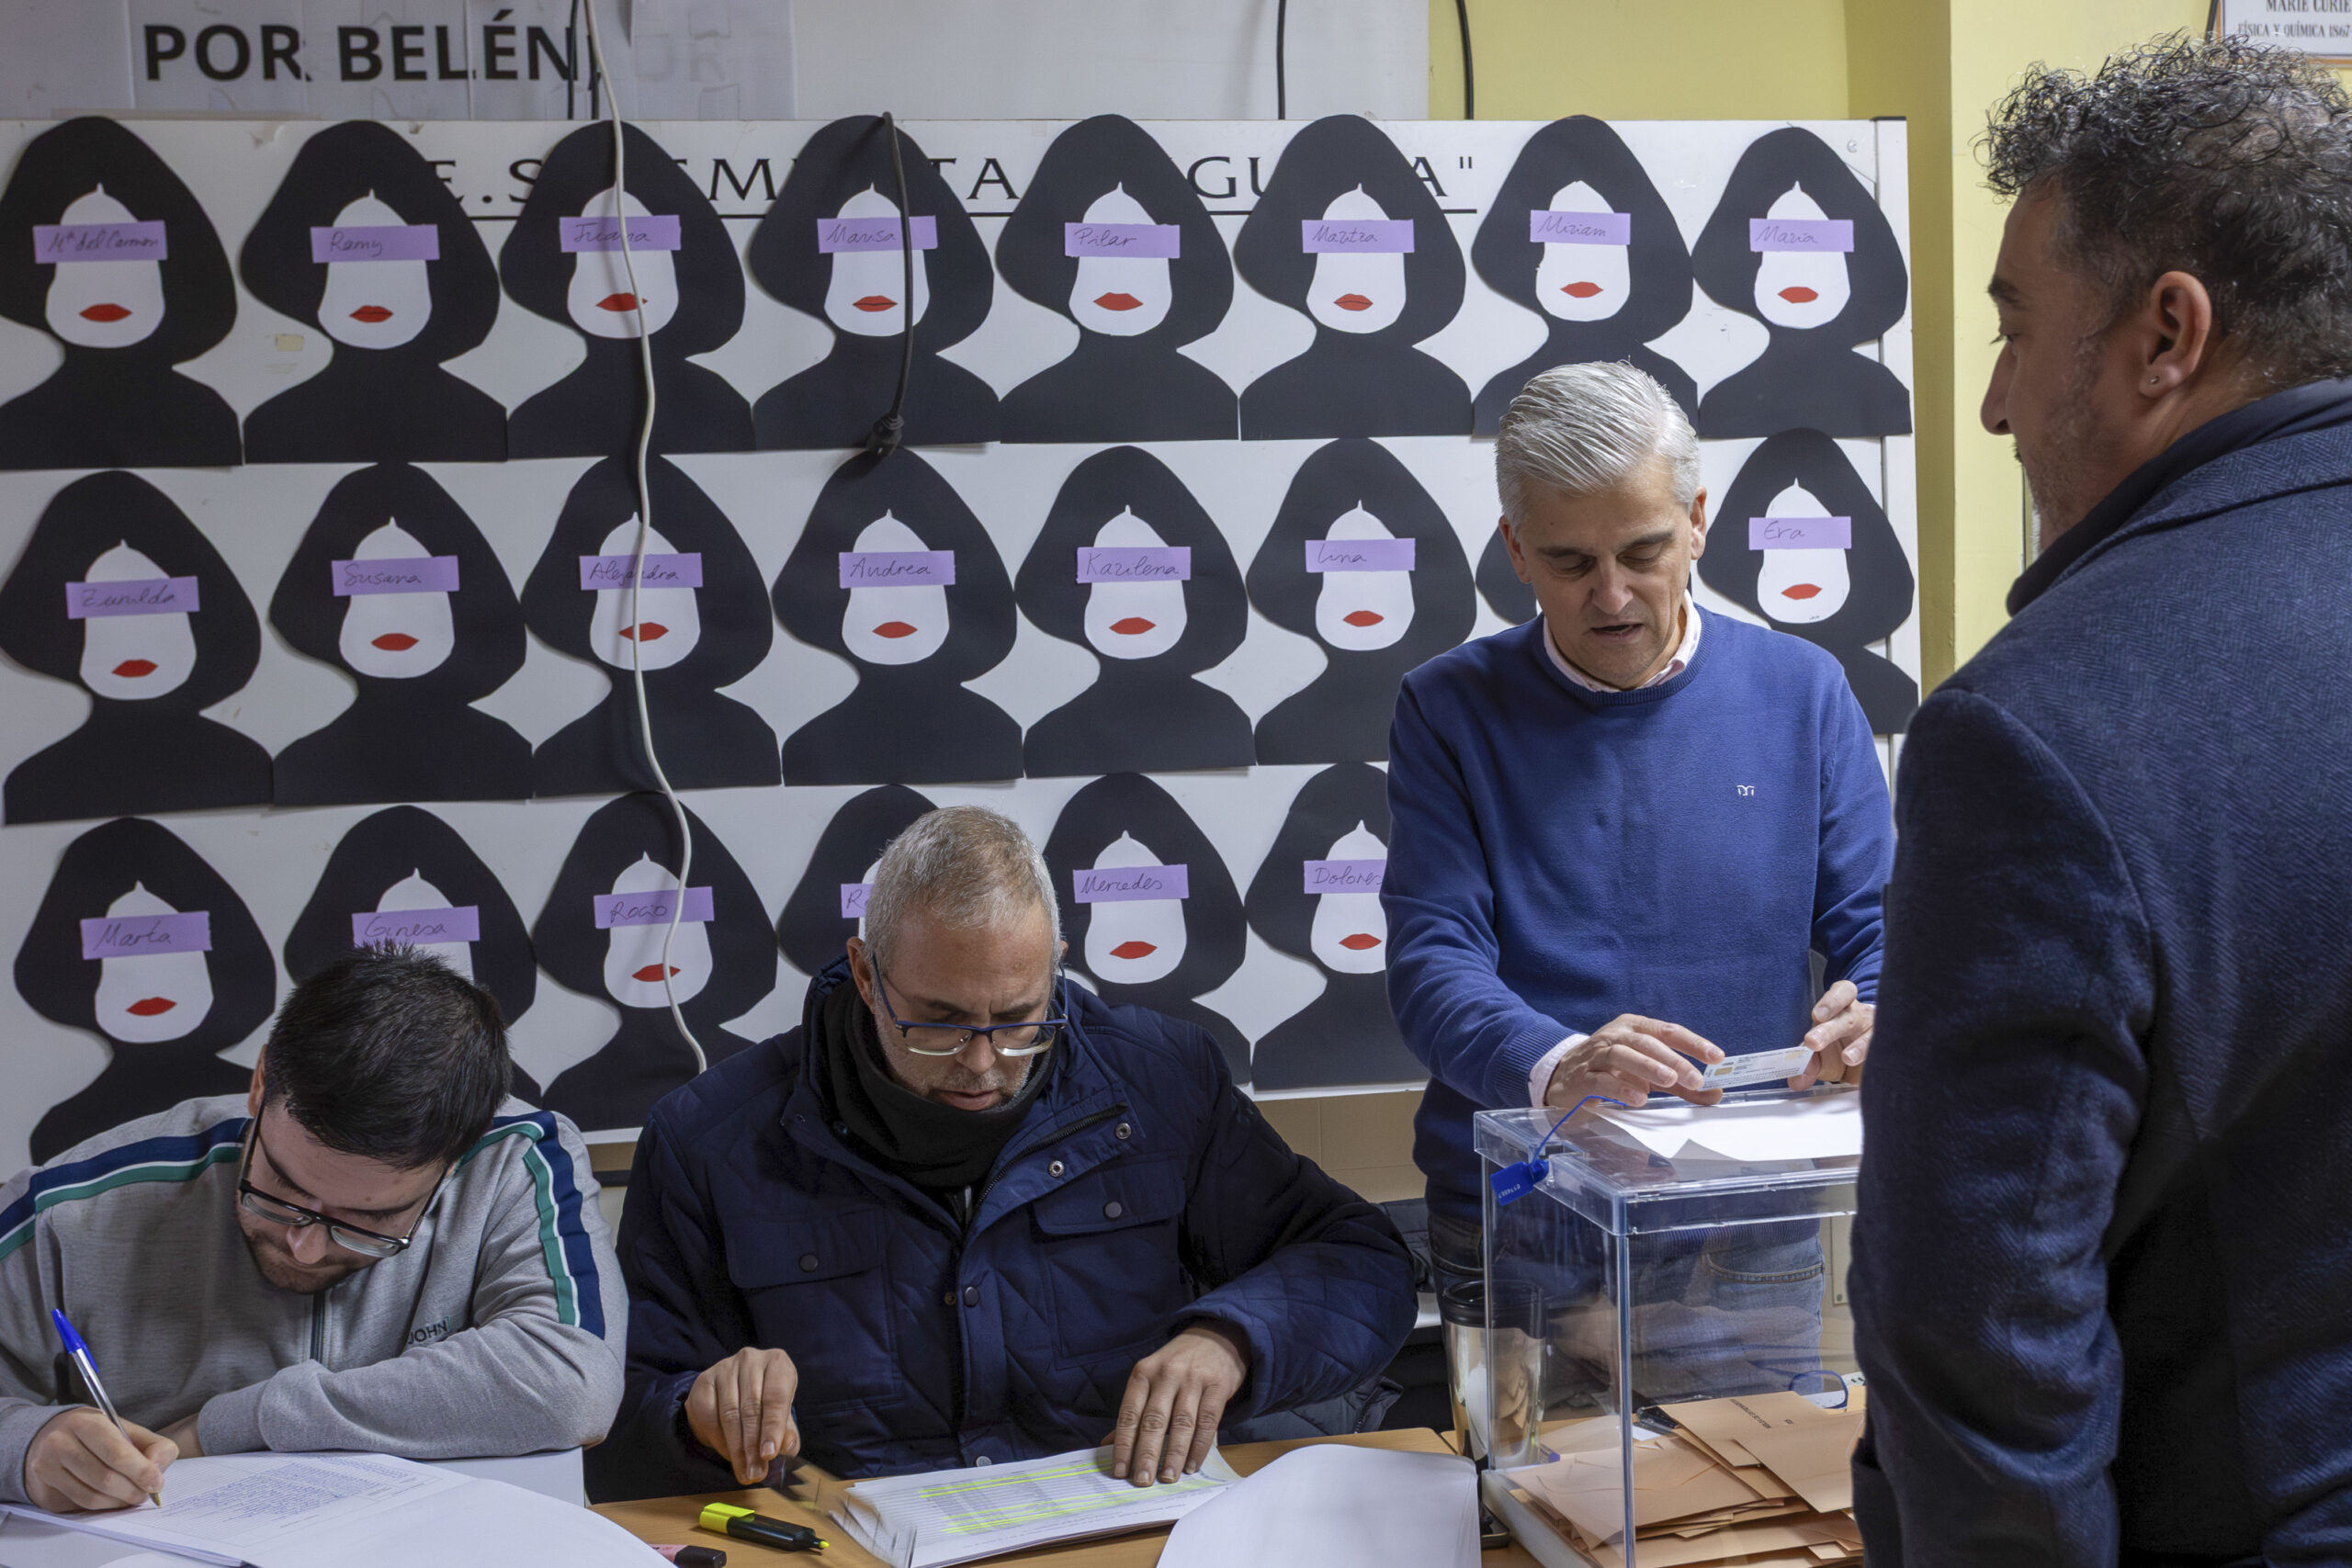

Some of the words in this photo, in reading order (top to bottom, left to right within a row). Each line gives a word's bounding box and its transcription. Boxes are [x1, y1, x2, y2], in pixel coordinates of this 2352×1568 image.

[2267, 0, 2309, 12] MARIE
[2313, 0, 2351, 13] CURIE
[2273, 23, 2281, 36] Y
[2283, 20, 2326, 38] QUÍMICA
[144, 24, 311, 82] POR
[1074, 227, 1137, 247] Pilar
[344, 562, 423, 588] Susana
[589, 559, 680, 587] Alejadra
[850, 558, 932, 580] Andrea
[1080, 873, 1164, 895] Mercedes
[93, 919, 172, 952] Marta
[408, 1319, 448, 1345] JOHN
